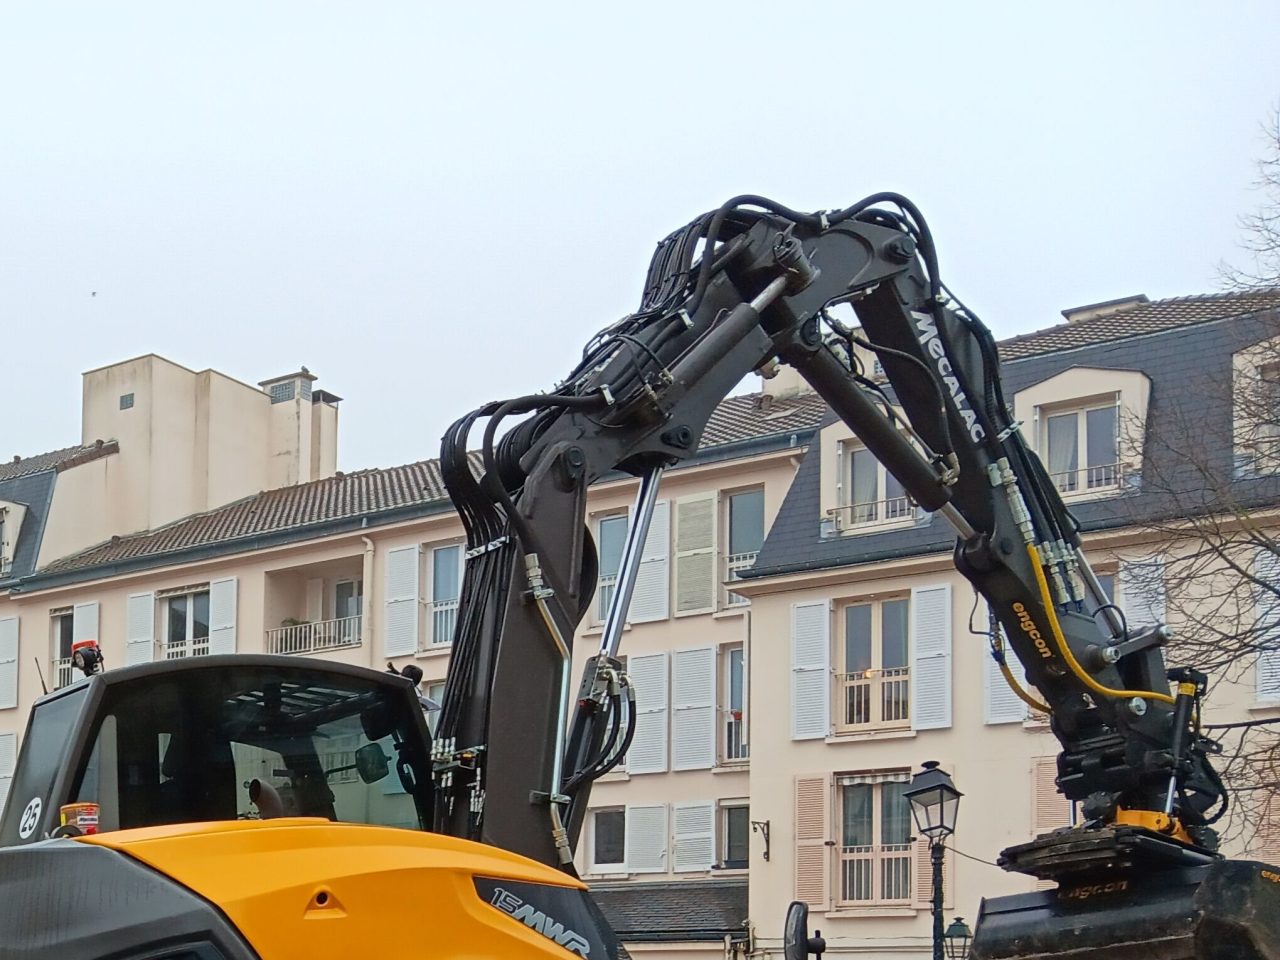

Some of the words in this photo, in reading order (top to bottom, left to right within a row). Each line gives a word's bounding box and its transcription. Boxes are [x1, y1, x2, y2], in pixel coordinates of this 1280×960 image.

[1012, 602, 1052, 658] engcon
[21, 803, 40, 833] 25
[490, 887, 591, 960] 15MWR
